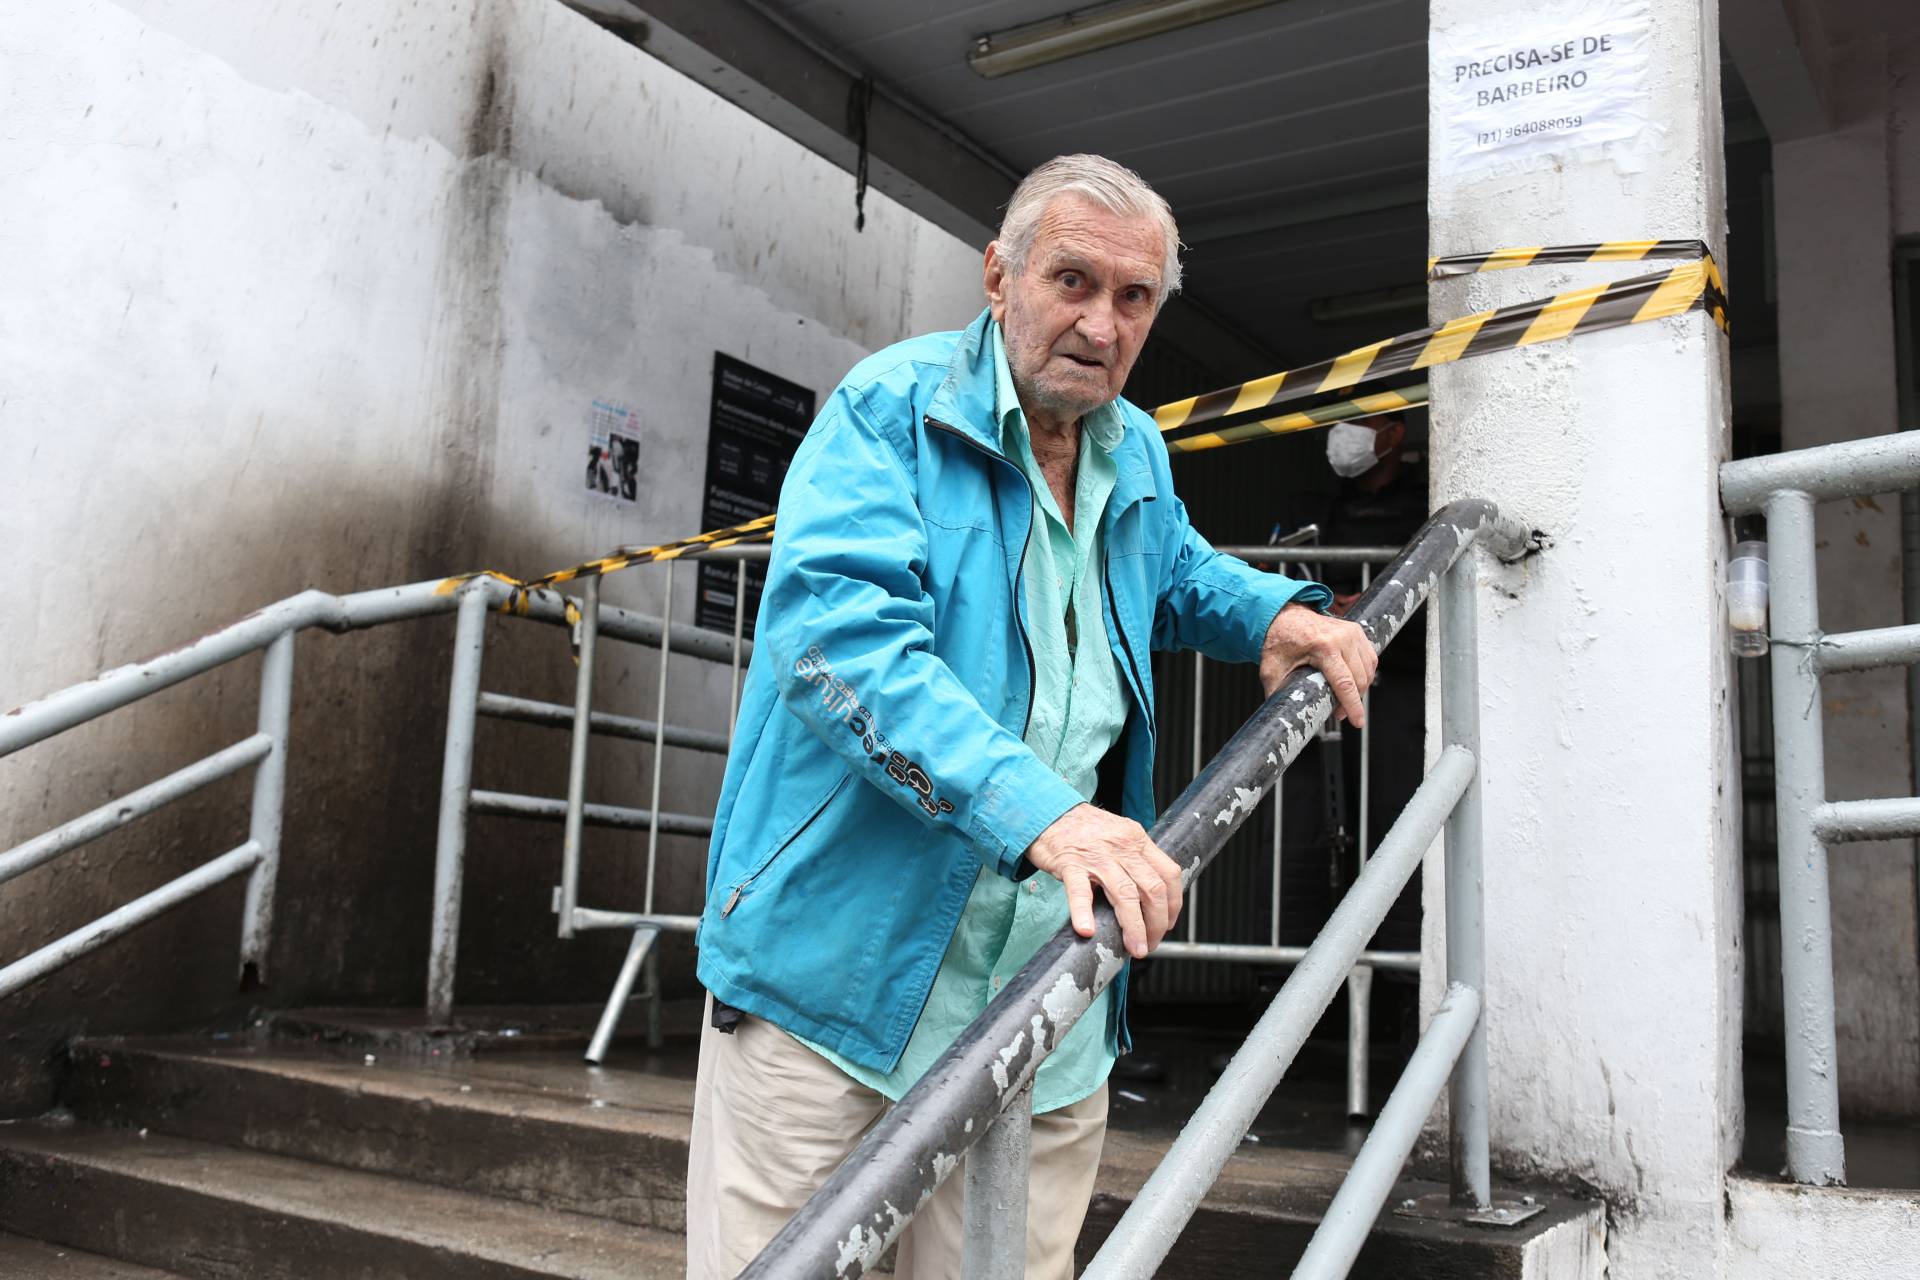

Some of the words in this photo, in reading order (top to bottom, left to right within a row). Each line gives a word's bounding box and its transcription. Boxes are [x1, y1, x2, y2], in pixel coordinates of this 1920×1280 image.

[1455, 40, 1575, 83] PRECISA-SE
[1582, 34, 1612, 55] DE
[1477, 70, 1588, 107] BARBEIRO
[1477, 129, 1503, 147] (21)
[1505, 115, 1583, 139] 964088059
